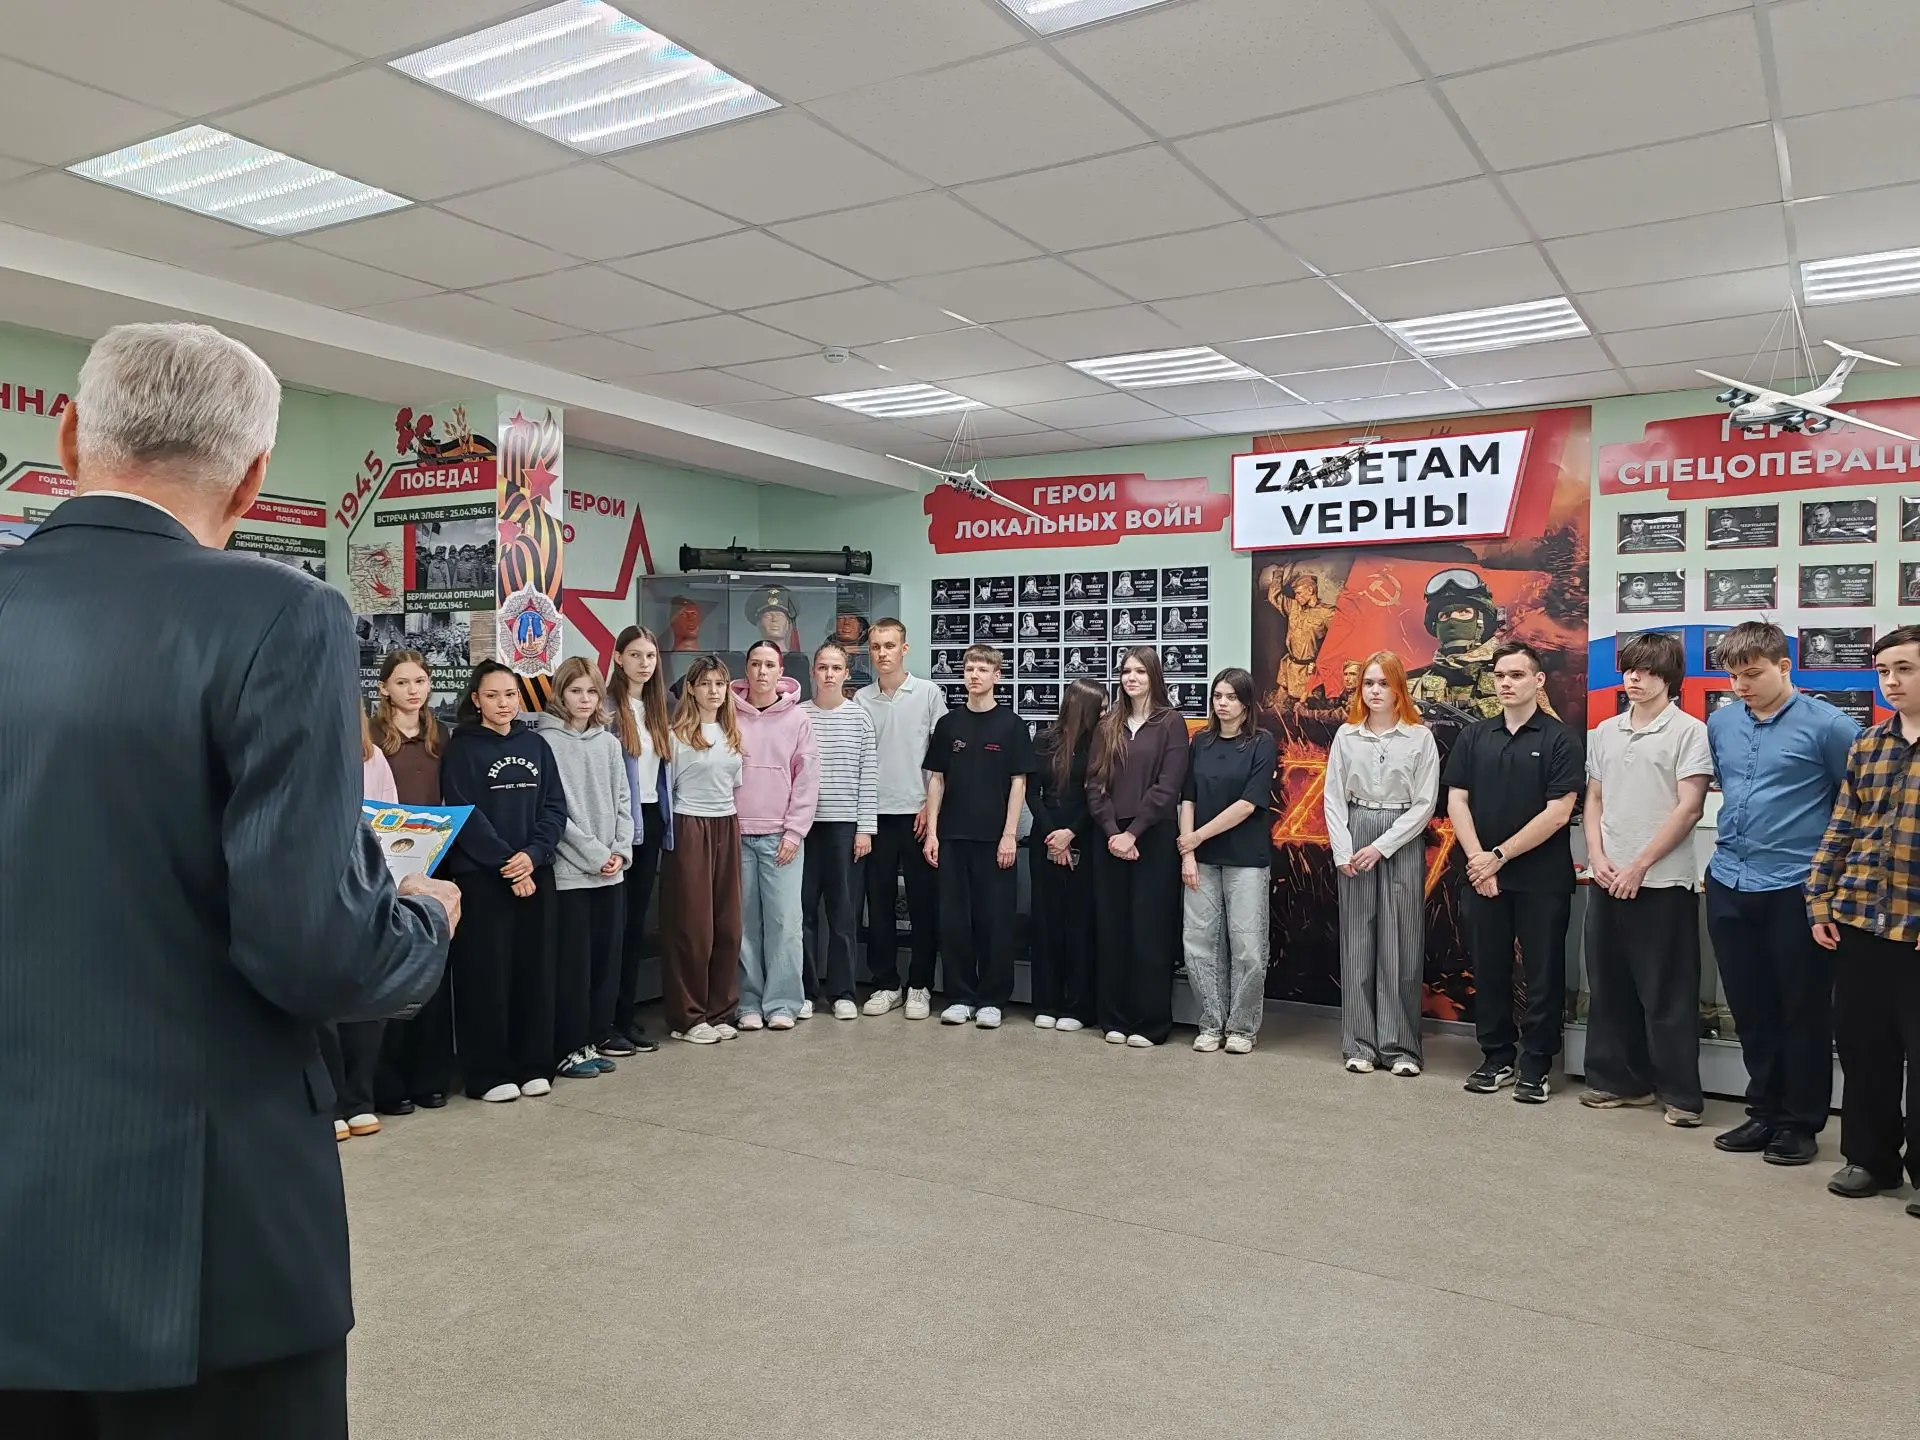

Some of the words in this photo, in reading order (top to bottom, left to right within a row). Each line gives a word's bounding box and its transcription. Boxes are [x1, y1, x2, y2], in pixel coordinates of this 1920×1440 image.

[334, 449, 384, 529] 1945
[400, 466, 479, 490] ПОБЕДА!
[1033, 481, 1116, 506] ГЕРОИ
[256, 503, 271, 511] ГОД
[376, 512, 408, 524] ВСТРЕЧА
[409, 512, 419, 521] НА
[421, 510, 445, 520] ЭЛЬБЕ
[449, 506, 487, 518] 25.04.1945
[276, 515, 301, 524] ПОБЕД
[954, 510, 1118, 540] ЛОКАЛЬНЫХ
[1125, 501, 1203, 530] ВОЙН
[406, 591, 453, 601] БЕРЛИНСКАЯ
[453, 589, 495, 600] ОПЕРАЦИЯ
[487, 756, 539, 779] HILFIGER
